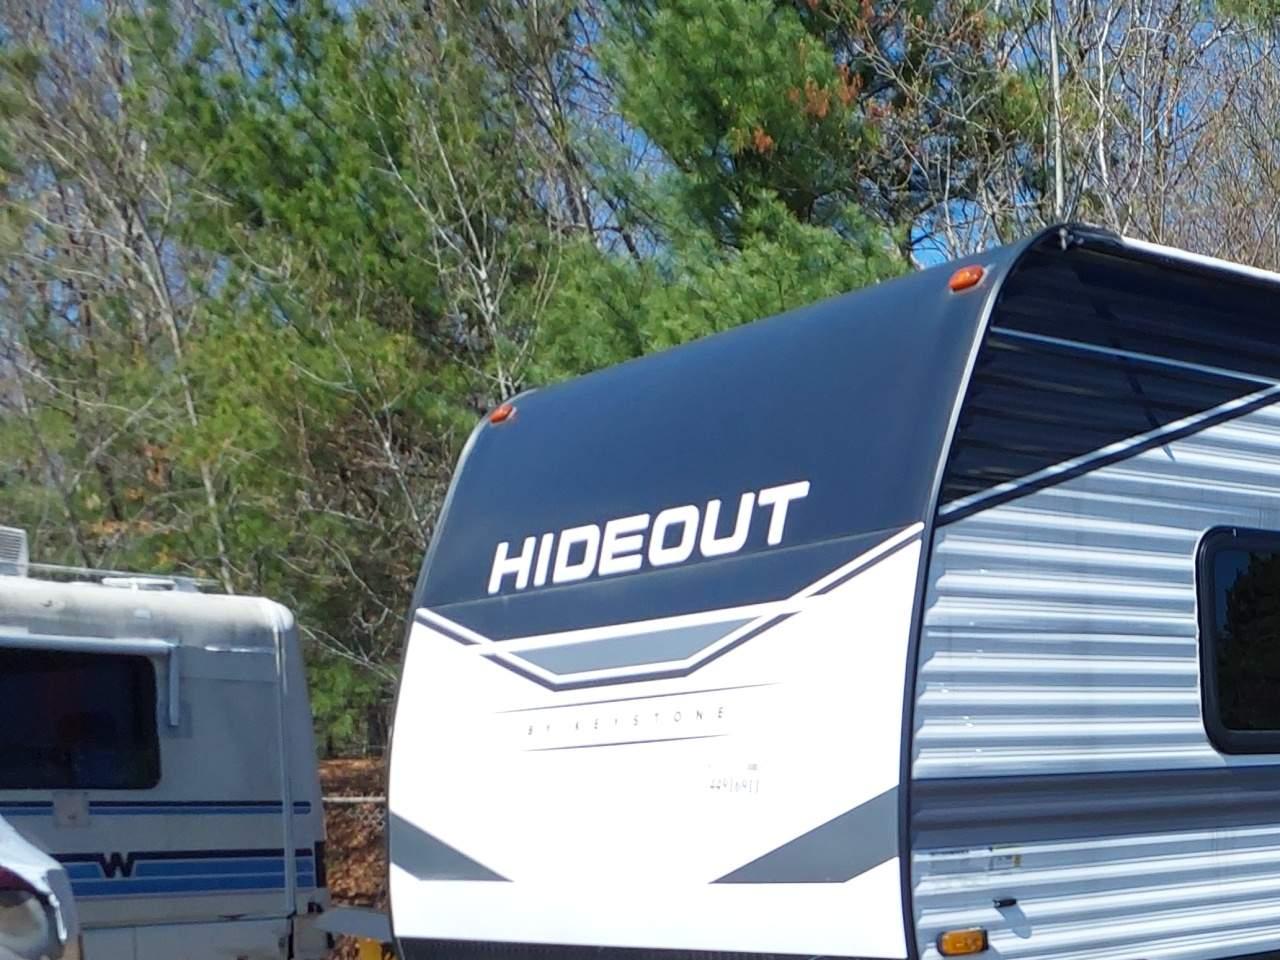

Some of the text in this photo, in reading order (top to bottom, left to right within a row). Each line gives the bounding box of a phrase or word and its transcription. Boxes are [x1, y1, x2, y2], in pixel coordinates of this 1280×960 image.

[488, 480, 810, 595] HIDEOUT
[527, 706, 726, 736] BY KEYSTONE
[98, 851, 136, 878] W
